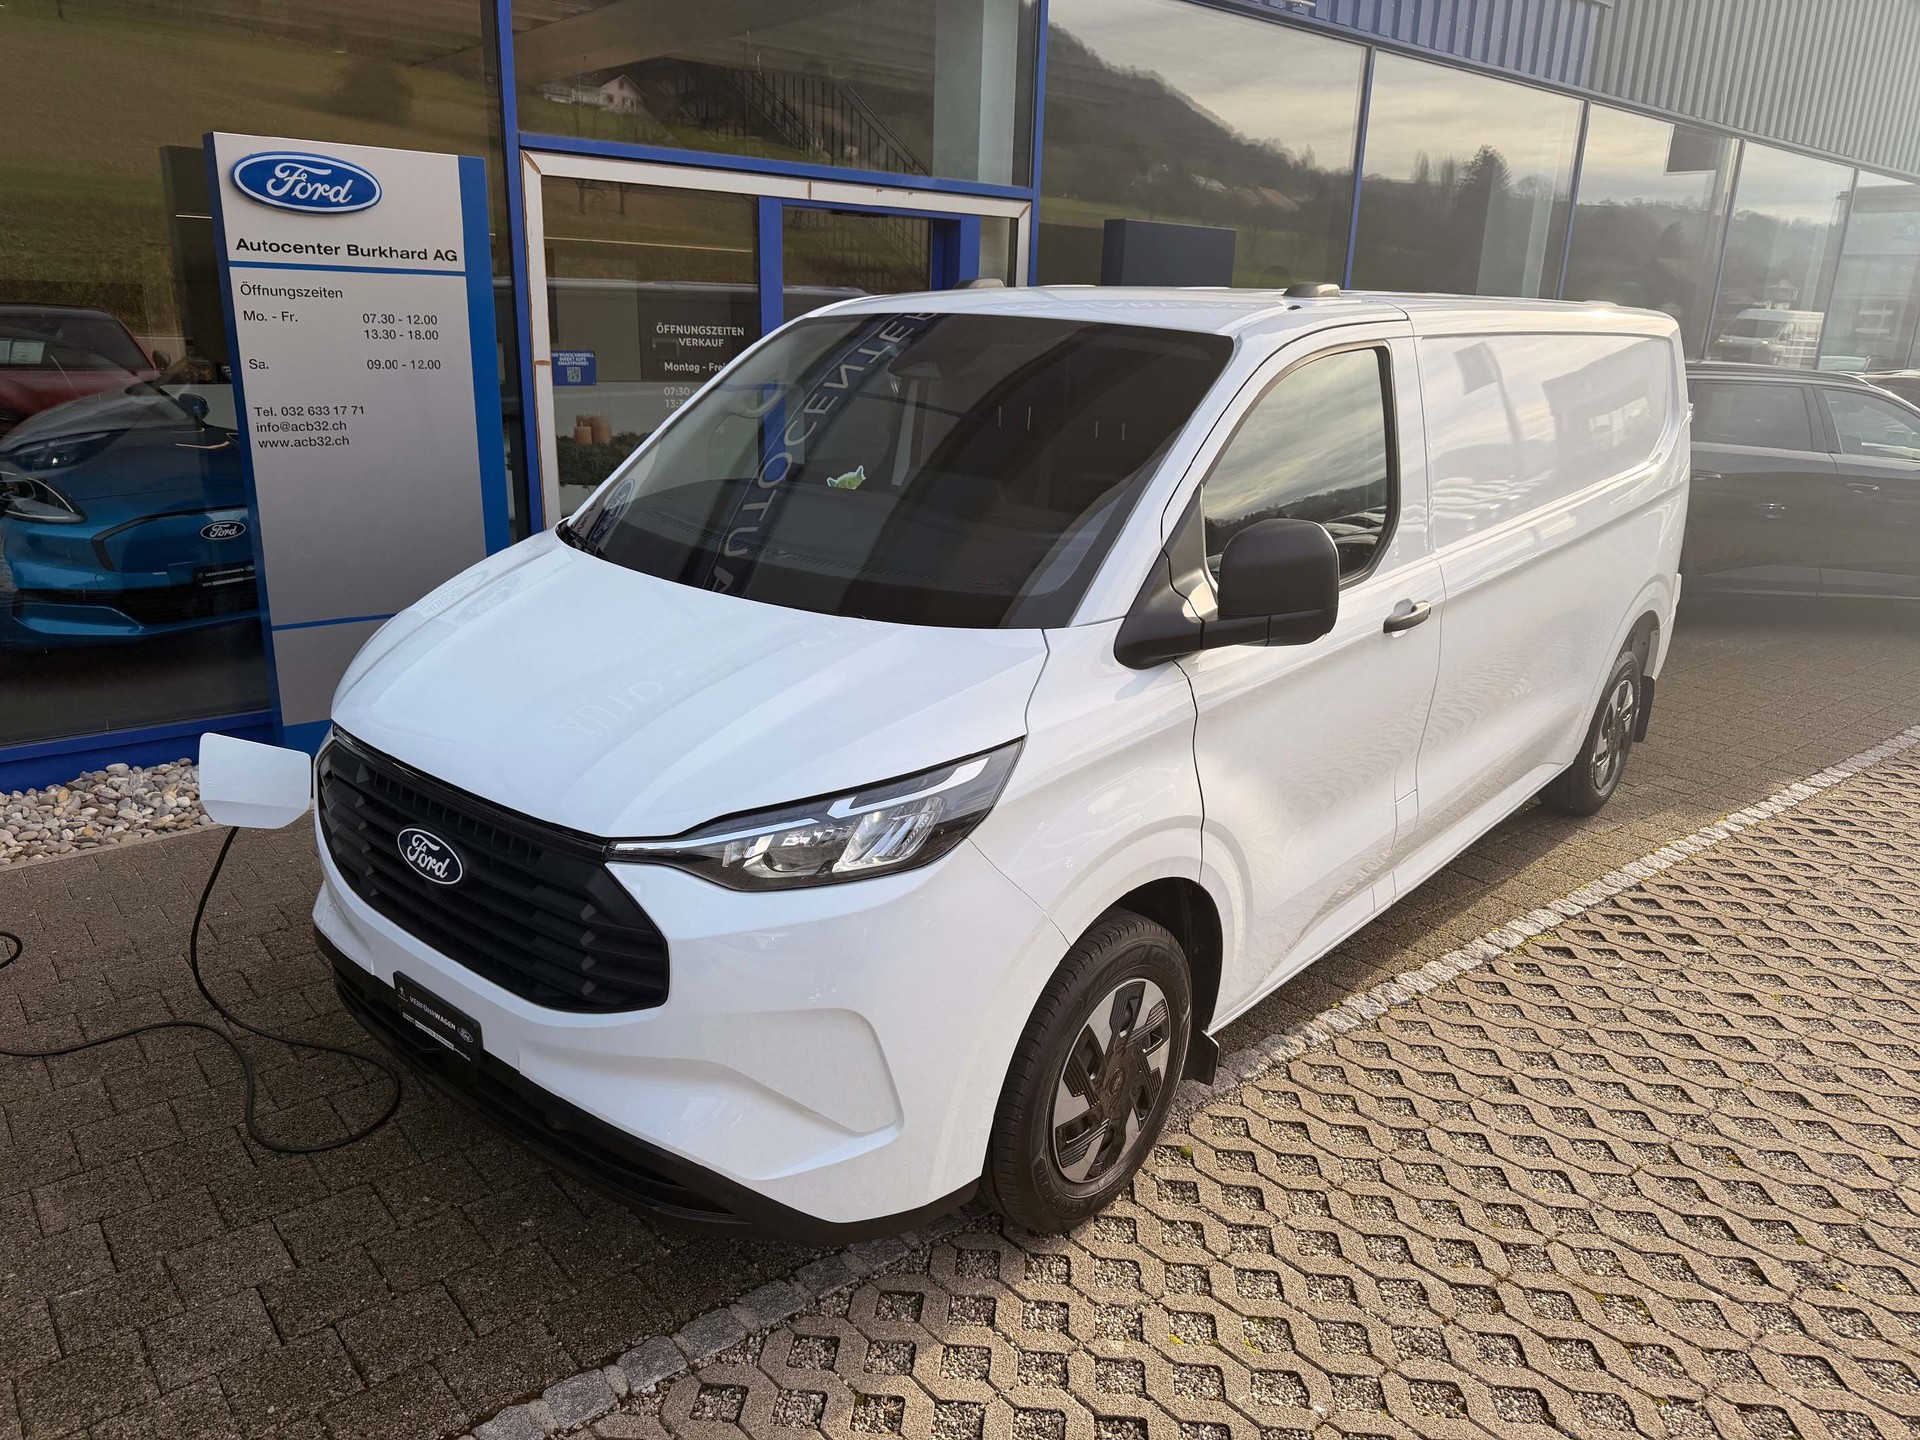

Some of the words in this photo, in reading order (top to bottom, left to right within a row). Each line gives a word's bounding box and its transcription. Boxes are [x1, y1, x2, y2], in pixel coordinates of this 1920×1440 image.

[266, 162, 354, 204] Ford
[235, 237, 341, 256] Autocenter
[346, 243, 428, 261] Burkhard
[433, 249, 458, 262] AG
[240, 281, 344, 300] Öffnungszeiten
[243, 310, 268, 322] Mo.
[281, 311, 299, 322] Fr.
[362, 313, 395, 325] 07.30
[407, 314, 438, 325] 12.00
[364, 329, 397, 340] 13.30
[408, 329, 439, 340] 18.00
[656, 321, 745, 336] ÖFFNUNGSZEITEN
[678, 337, 724, 347] VERKAUF
[248, 358, 270, 370] Sa.
[366, 359, 399, 370] 09.00
[410, 359, 441, 370] 12.00
[664, 361, 700, 373] Montag
[663, 386, 690, 396] 07:30
[254, 406, 277, 417] Tel.
[281, 406, 304, 417] 032
[307, 406, 330, 416] 633
[334, 405, 348, 415] 17
[351, 405, 365, 415] 71
[256, 420, 347, 433] info@acb32.ch
[258, 435, 350, 448] www.acb32.ch
[406, 833, 451, 879] Ford
[409, 995, 456, 1030] VERFÜHRWAGEN
